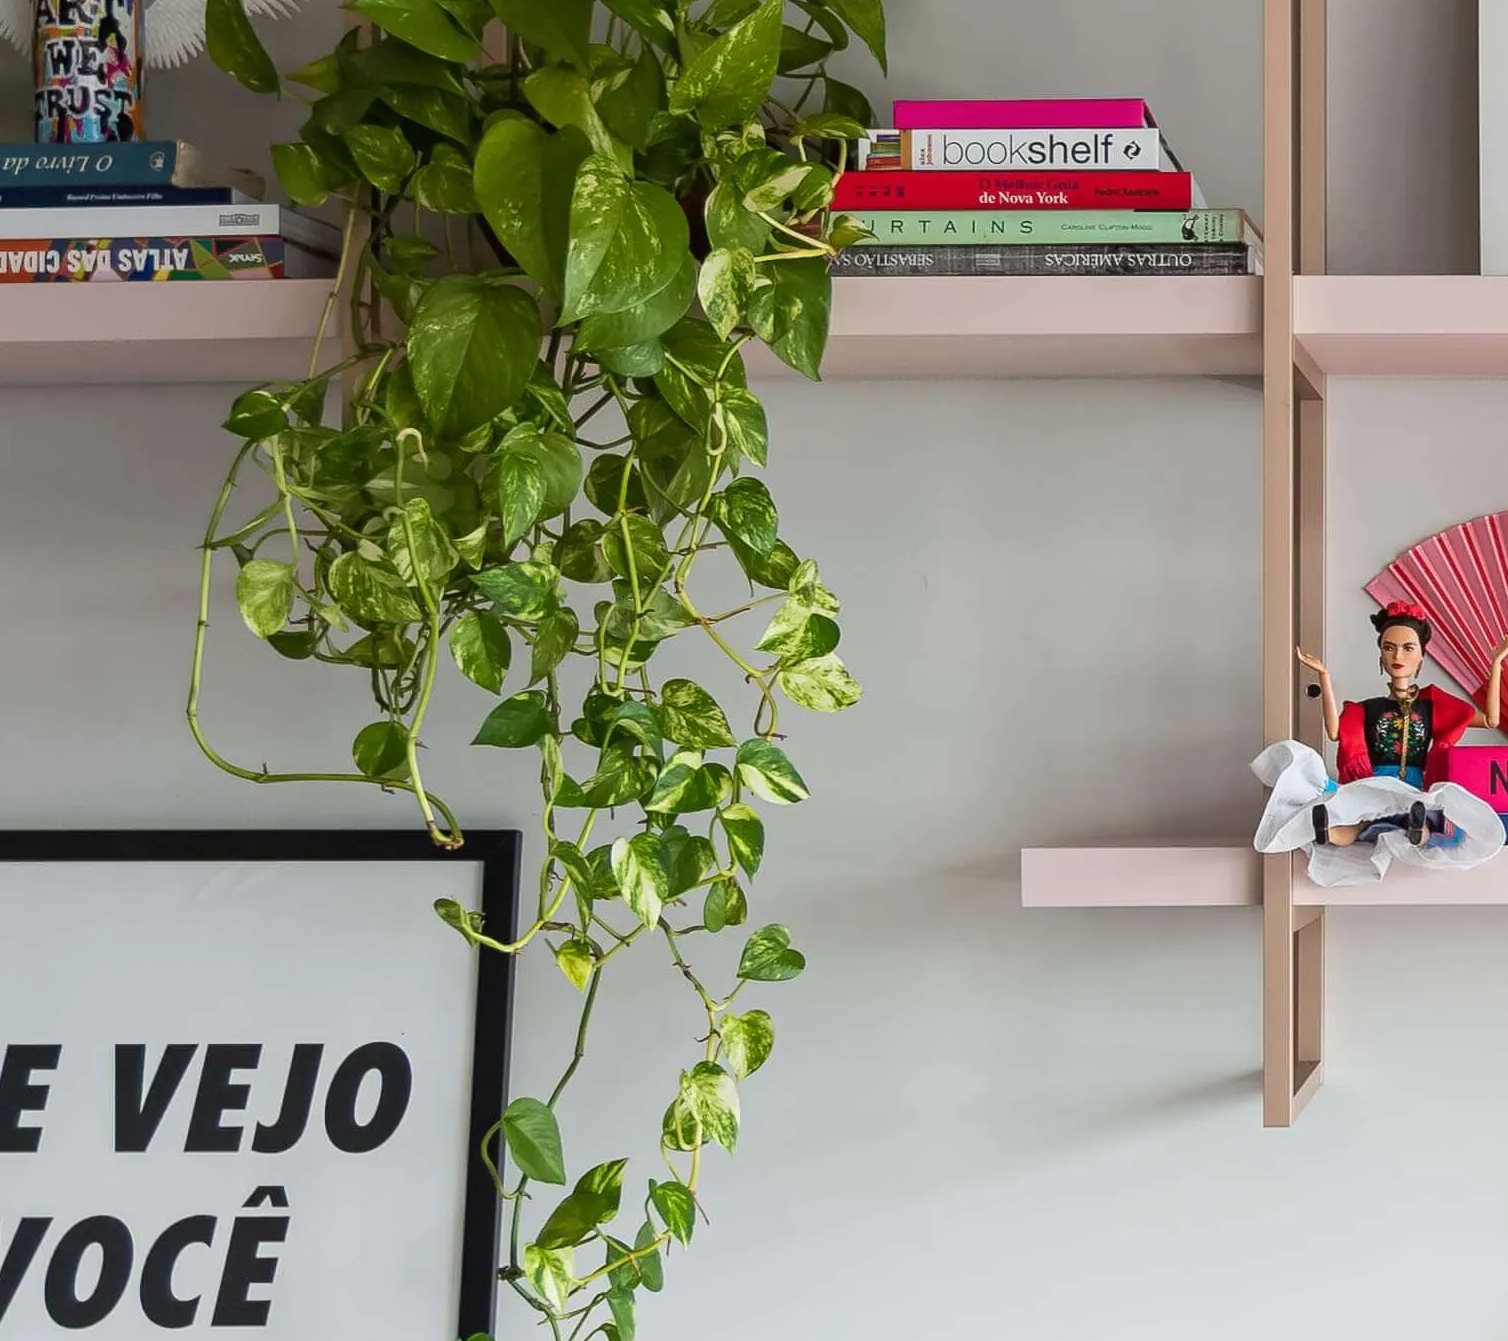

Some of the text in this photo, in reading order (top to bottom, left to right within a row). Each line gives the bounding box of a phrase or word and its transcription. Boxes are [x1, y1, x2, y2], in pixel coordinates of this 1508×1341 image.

[46, 39, 104, 76] WE
[35, 85, 133, 118] TRUST
[943, 133, 1113, 165] bookshelf
[1, 156, 32, 176] da
[35, 155, 90, 175] Livro
[95, 154, 113, 172] O
[979, 191, 1069, 204] de Nova York
[862, 219, 1034, 235] URTAINS
[67, 249, 112, 274] DAS
[118, 247, 189, 273] ATLAS
[854, 253, 935, 269] SEBASTIÃO
[1044, 253, 1193, 269] OUTRAS AMÉRICAS
[112, 1040, 413, 1155] VEJO
